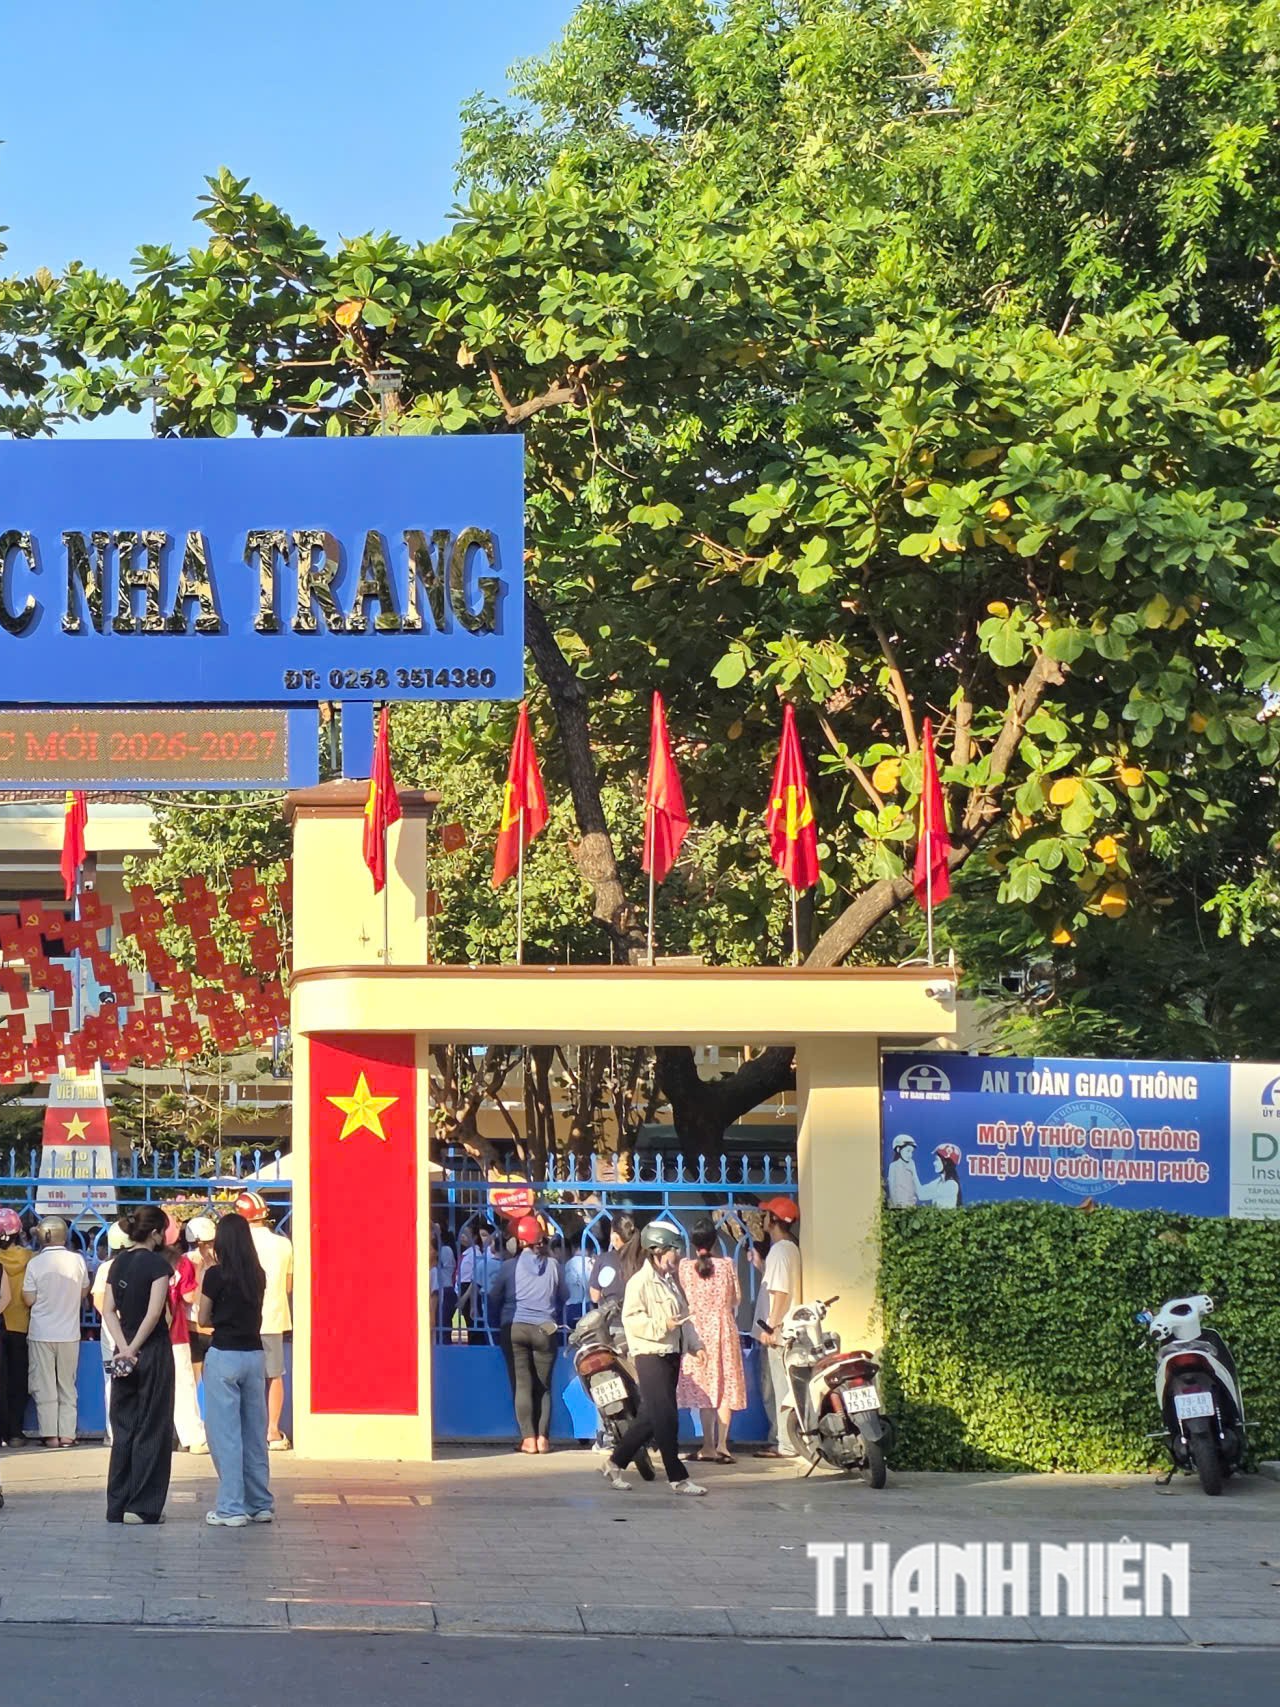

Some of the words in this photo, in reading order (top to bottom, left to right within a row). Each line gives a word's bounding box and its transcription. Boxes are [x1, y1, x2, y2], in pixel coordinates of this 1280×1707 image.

[60, 529, 222, 633] NHA
[243, 526, 503, 633] TRANG
[284, 669, 321, 690] ĐT:
[329, 668, 390, 690] 0258
[396, 667, 497, 689] 3514380
[24, 723, 99, 762] MỚI
[110, 730, 277, 762] 2026-2027
[980, 1070, 1010, 1094] AN
[1015, 1067, 1070, 1096] TOÀN
[1075, 1073, 1124, 1099] GIAO
[1129, 1071, 1199, 1101] THÔNG
[977, 1121, 1018, 1150] MỘT
[1021, 1121, 1035, 1146] Ý
[1038, 1123, 1086, 1148] THỨC
[1090, 1127, 1134, 1150] GIAO
[1137, 1125, 1200, 1152] THÔNG
[967, 1152, 1020, 1181] TRIỆU
[1023, 1156, 1051, 1183] NỤ
[1055, 1153, 1099, 1179] CƯỜI
[1103, 1159, 1155, 1185] HẠNH
[1158, 1156, 1210, 1185] PHÚC
